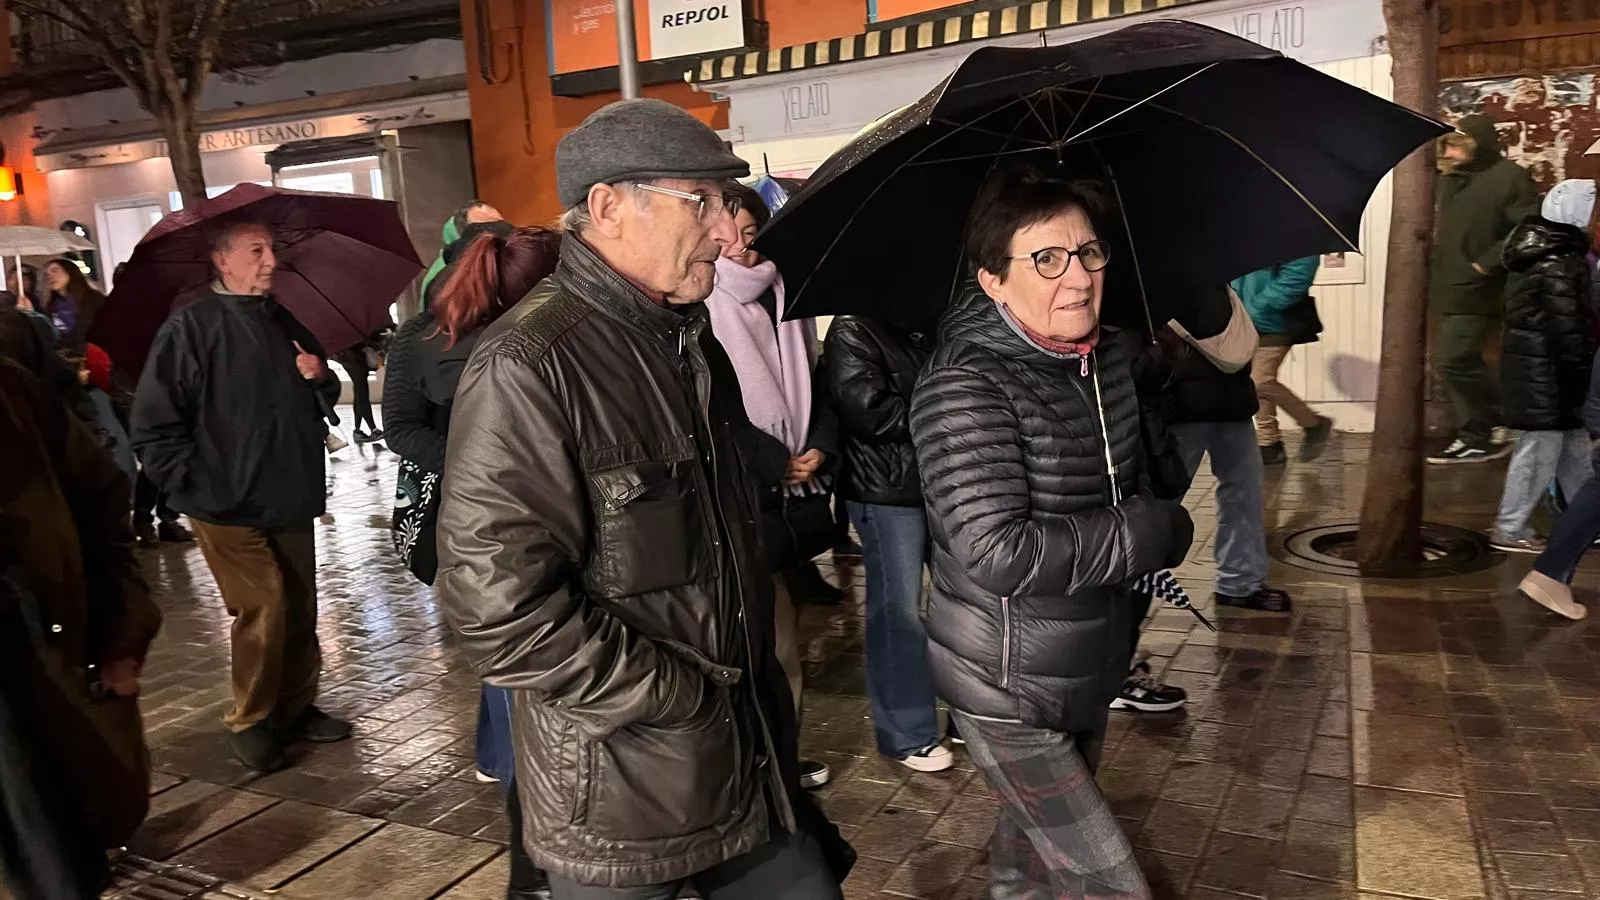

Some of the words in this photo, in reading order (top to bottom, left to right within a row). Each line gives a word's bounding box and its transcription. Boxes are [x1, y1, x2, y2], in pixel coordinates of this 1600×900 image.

[662, 5, 729, 28] REPSOL
[781, 81, 831, 134] XELATO
[221, 121, 316, 148] ARTESANO
